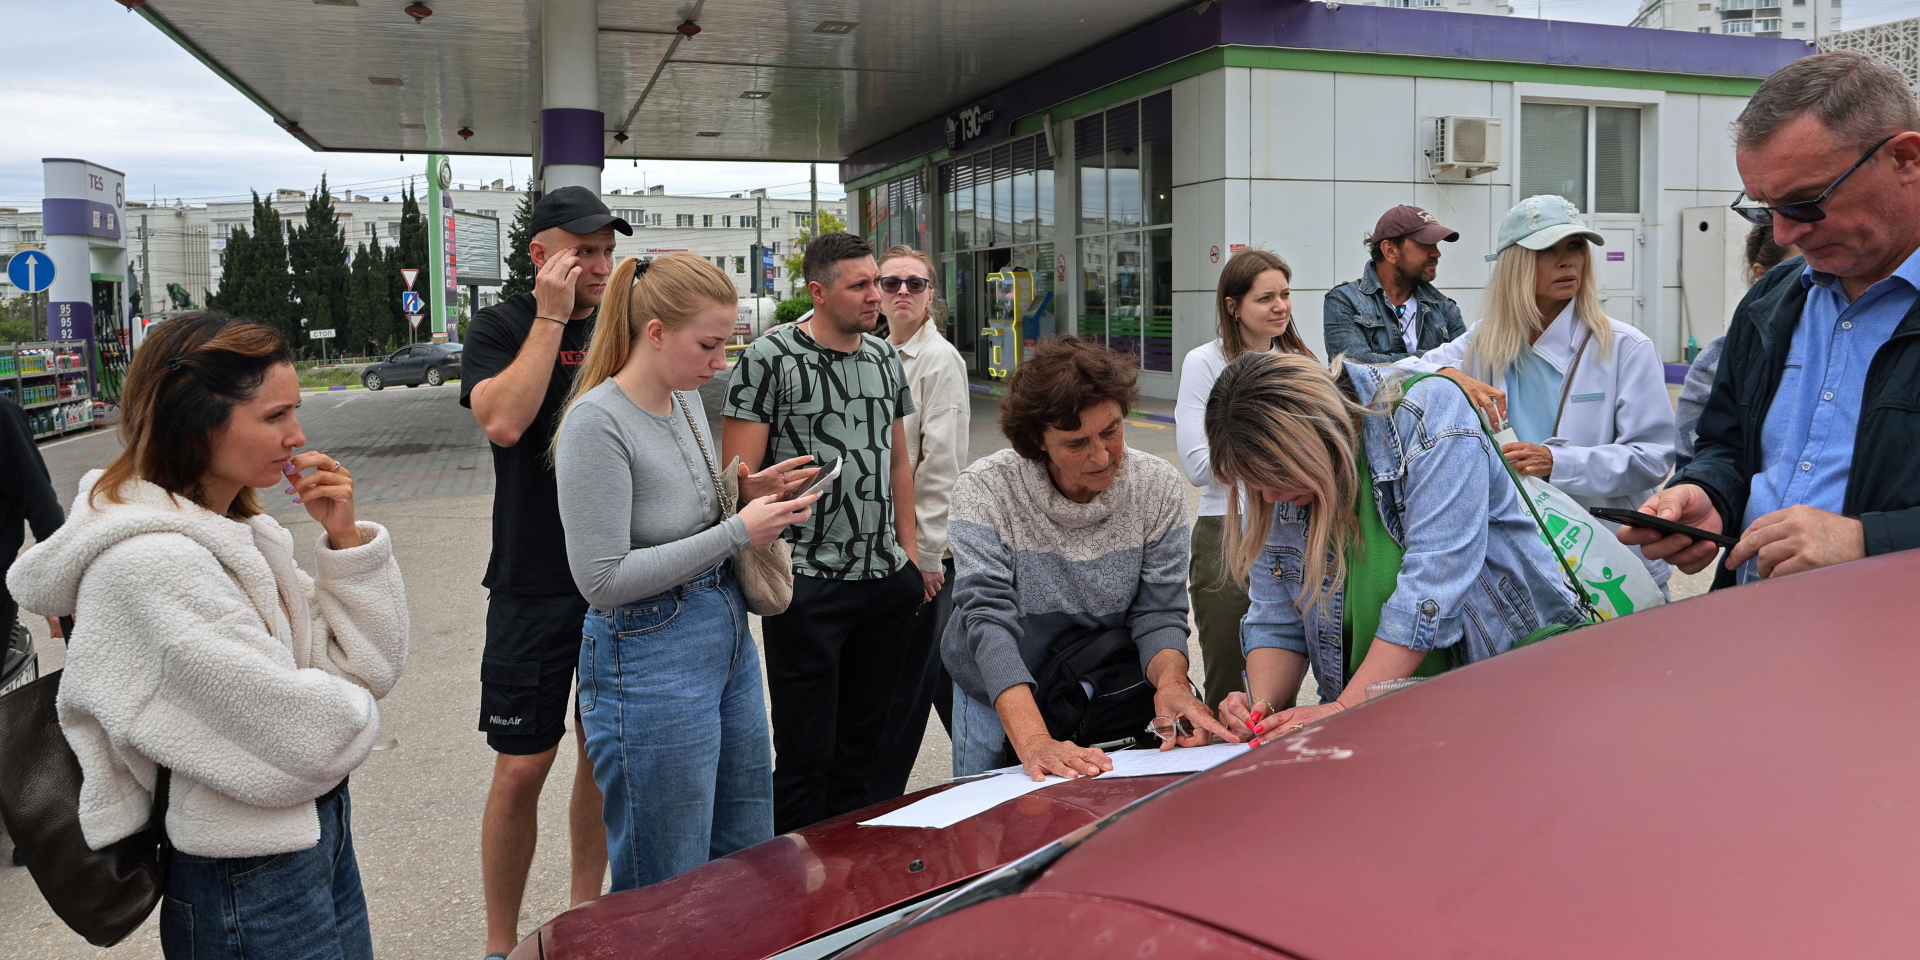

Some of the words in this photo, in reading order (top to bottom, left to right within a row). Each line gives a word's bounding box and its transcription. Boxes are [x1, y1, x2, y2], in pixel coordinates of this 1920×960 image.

[960, 105, 981, 141] ТЭС
[89, 173, 103, 191] TES
[116, 182, 122, 209] 6
[60, 304, 71, 314] 95
[61, 318, 72, 327] 95
[61, 329, 73, 339] 92
